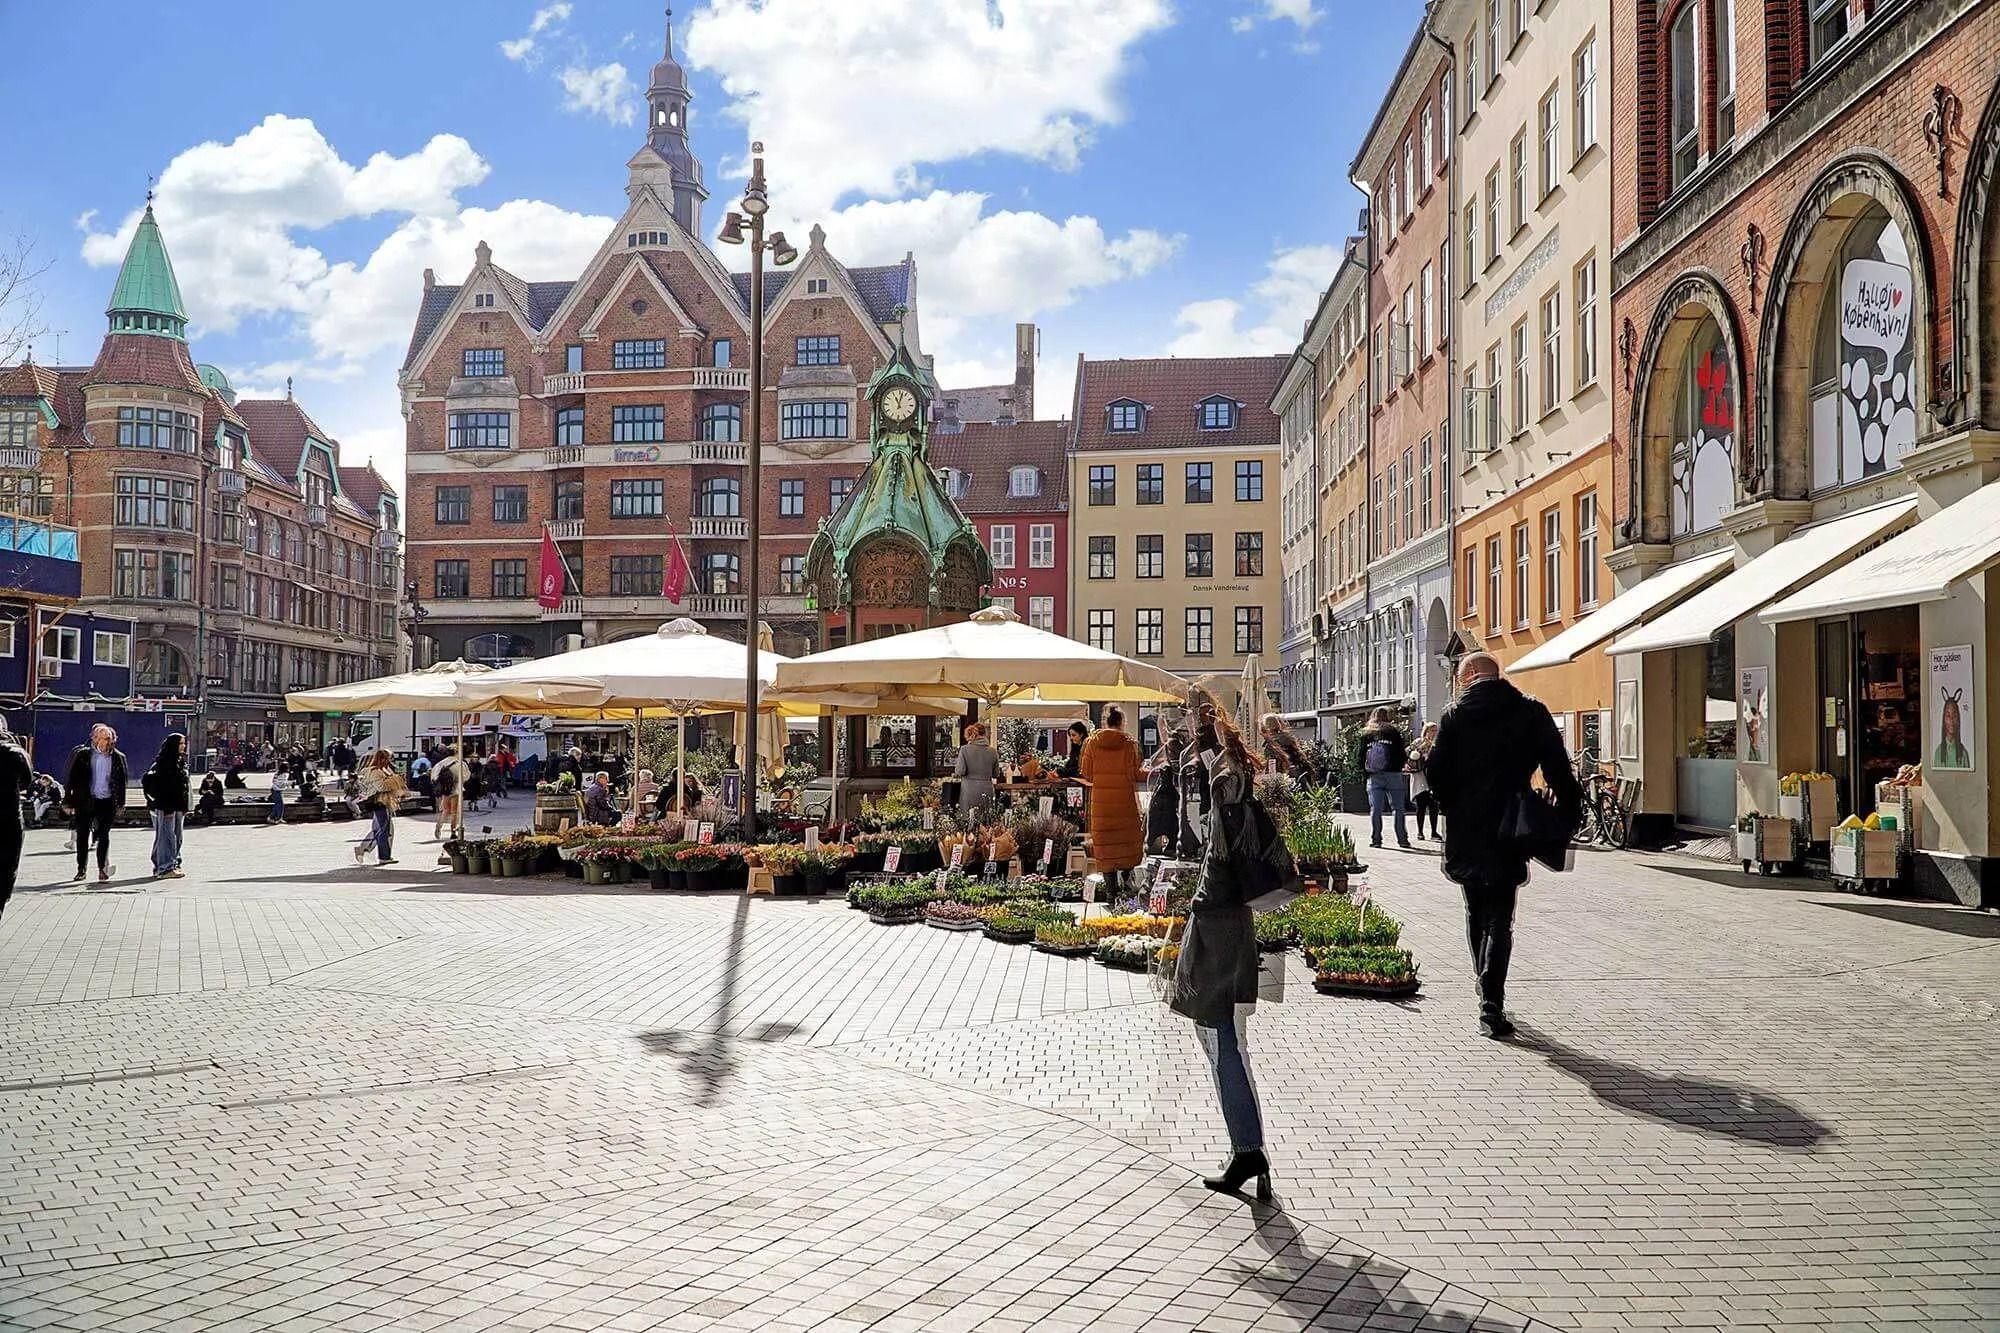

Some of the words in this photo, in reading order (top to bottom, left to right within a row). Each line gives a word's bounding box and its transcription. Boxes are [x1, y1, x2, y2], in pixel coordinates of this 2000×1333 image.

[1858, 280, 1893, 312] Halløj
[1843, 301, 1908, 338] København!
[1019, 577, 1027, 589] 5
[1192, 584, 1213, 592] Dansk
